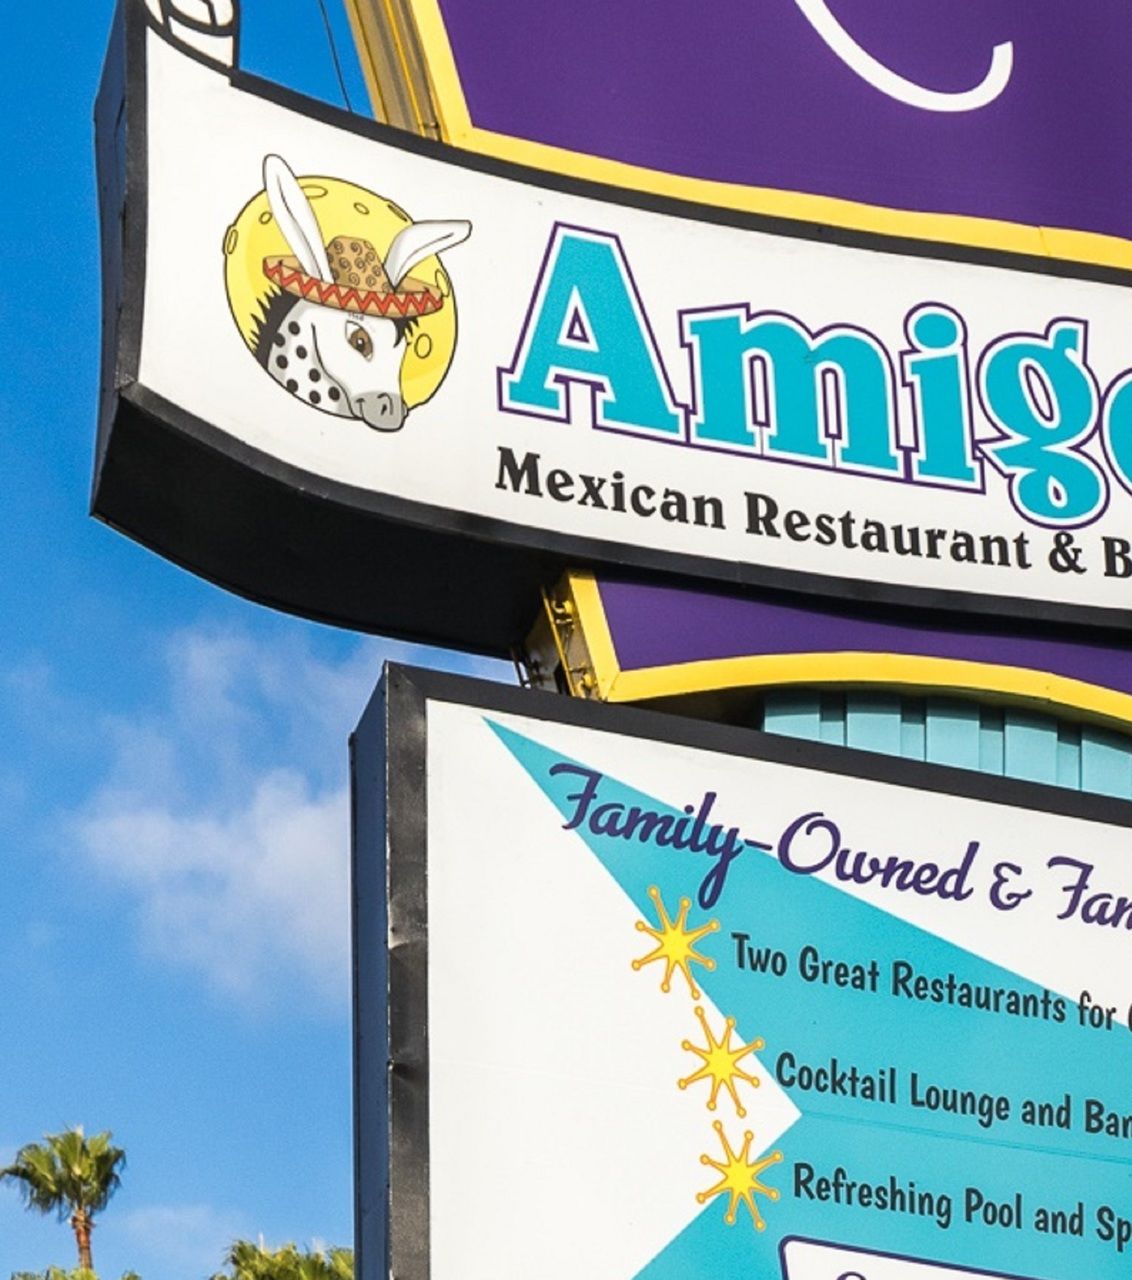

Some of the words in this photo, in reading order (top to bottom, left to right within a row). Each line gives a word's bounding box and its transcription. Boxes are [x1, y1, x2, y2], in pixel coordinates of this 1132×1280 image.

[495, 446, 727, 530] Mexican
[744, 491, 1033, 569] Restaurant
[1047, 531, 1087, 575] &
[549, 762, 980, 910] Family-Owned
[988, 861, 1033, 911] &
[731, 932, 788, 978] Two
[799, 946, 880, 993] Great
[892, 960, 1067, 1025] Restaurants
[1077, 989, 1117, 1032] for
[776, 1052, 897, 1105] Cocktail
[910, 1073, 1011, 1128] Lounge
[1021, 1094, 1072, 1130] and
[793, 1163, 953, 1229] Refreshing
[964, 1188, 1022, 1230] Pool
[1034, 1202, 1084, 1237] and
